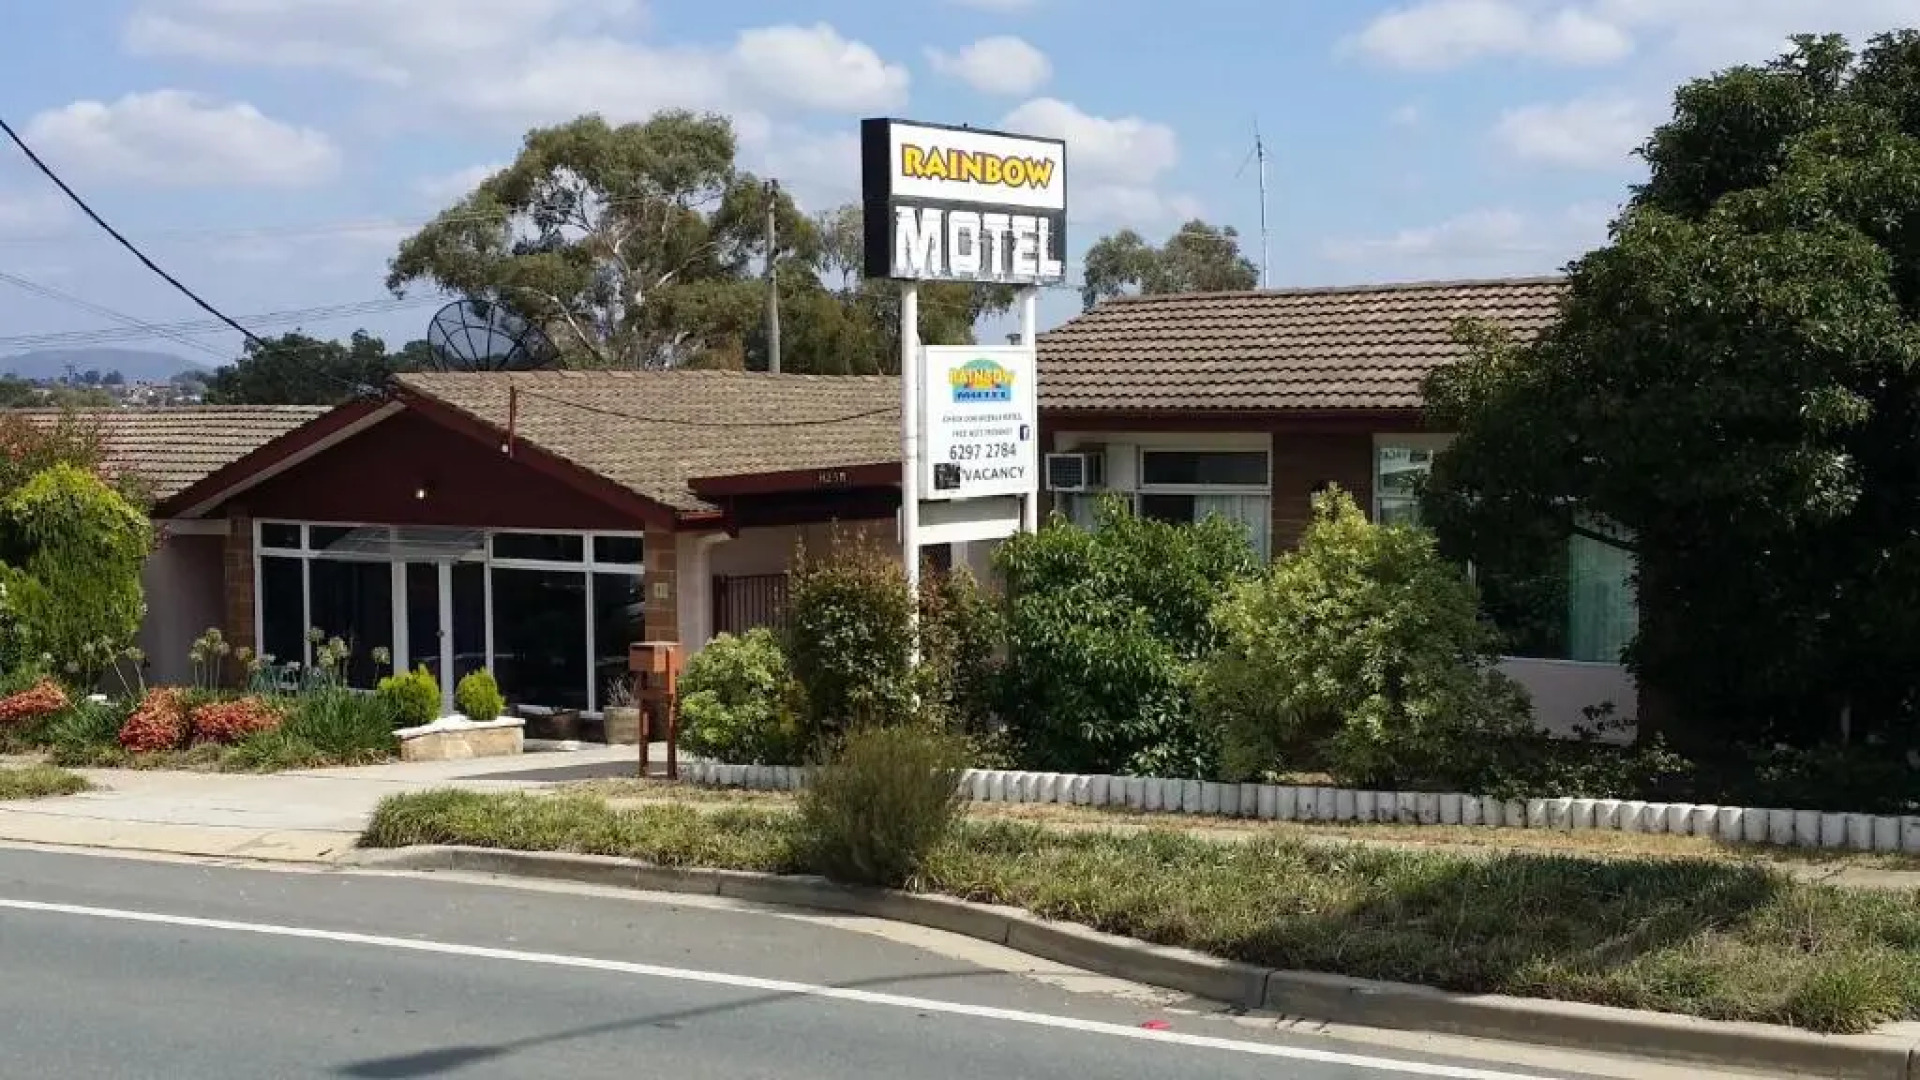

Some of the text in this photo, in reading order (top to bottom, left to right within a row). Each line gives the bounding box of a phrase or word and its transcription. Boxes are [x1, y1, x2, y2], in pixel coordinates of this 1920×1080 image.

[902, 143, 1055, 189] RAINBOW
[895, 205, 1062, 279] MOTEL
[949, 442, 1017, 460] 6297 2784
[961, 466, 1025, 481] VACANCY
